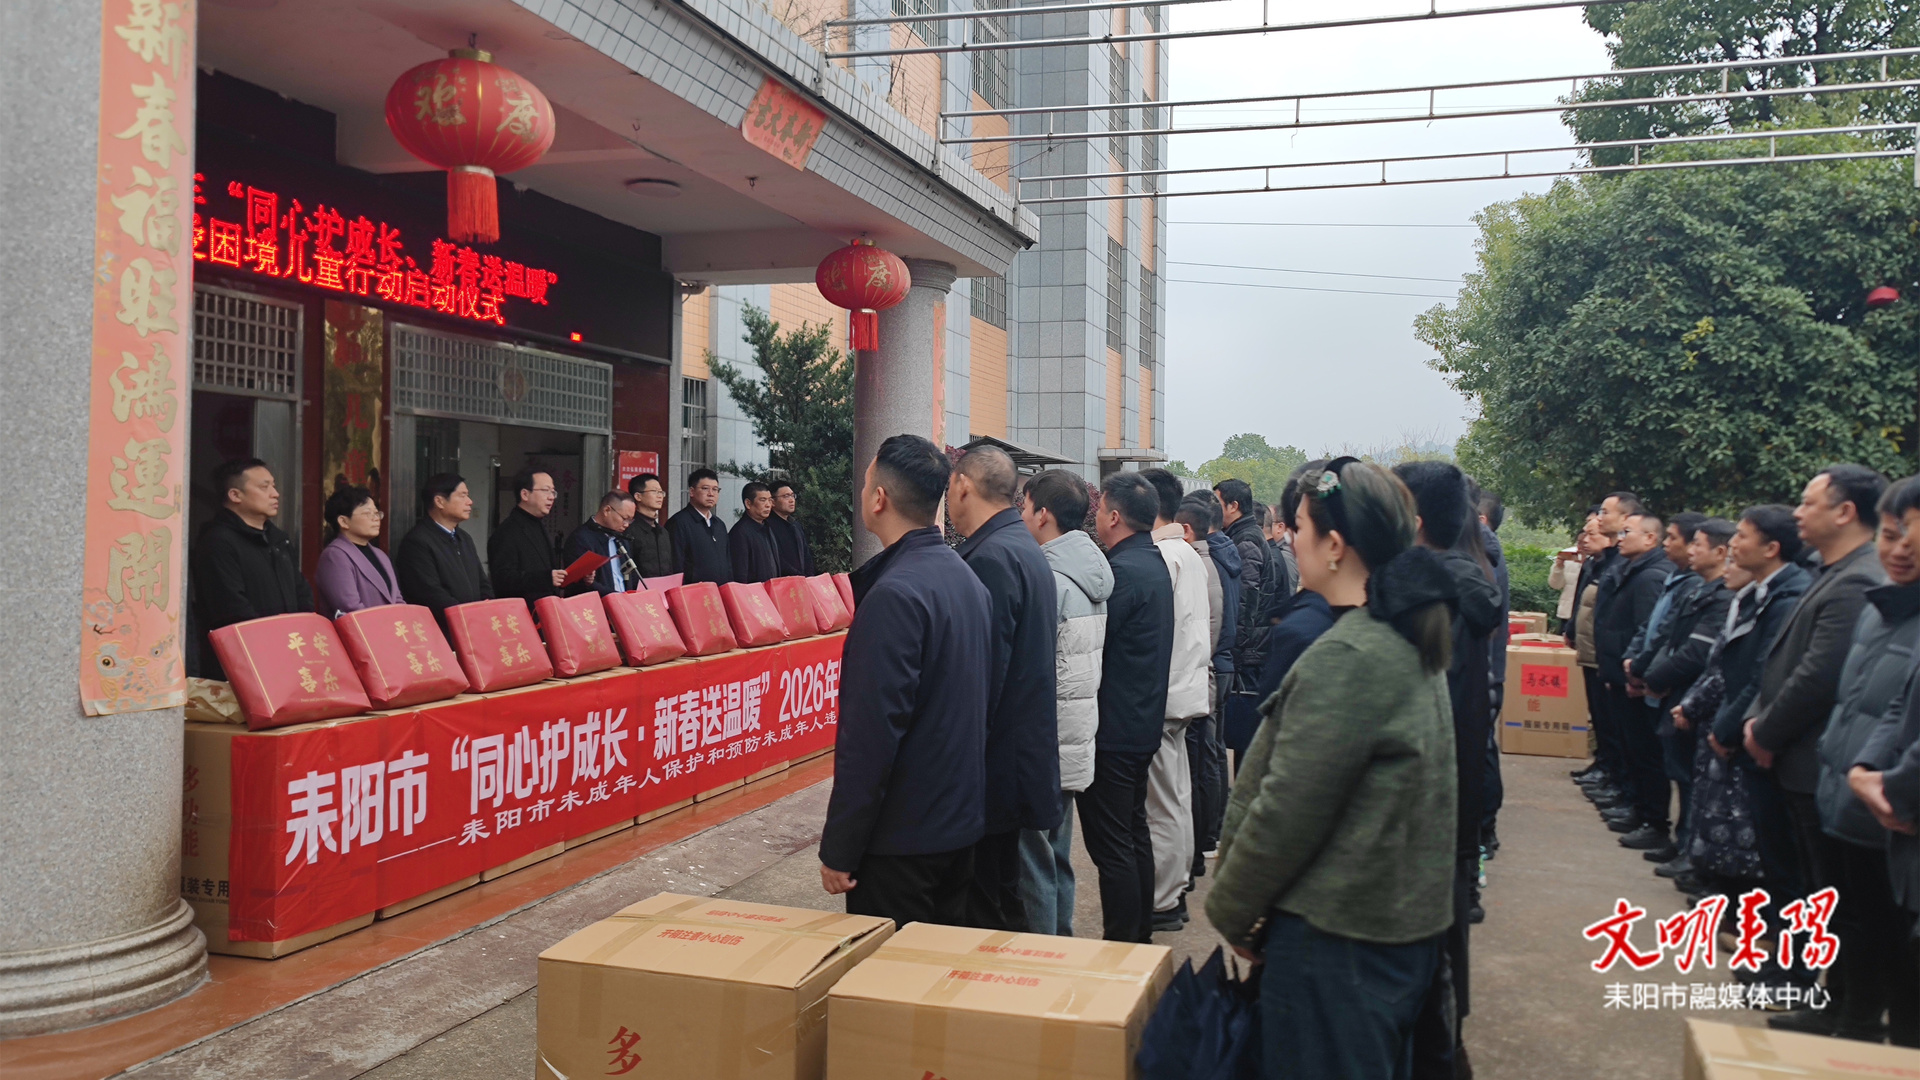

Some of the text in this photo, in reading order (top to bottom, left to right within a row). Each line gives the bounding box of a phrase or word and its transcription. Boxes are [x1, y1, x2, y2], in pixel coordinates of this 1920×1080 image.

[490, 614, 520, 636] 平安
[570, 608, 597, 629] 平安
[394, 620, 428, 643] 平安
[288, 632, 330, 656] 平安
[499, 643, 531, 667] 喜乐
[406, 650, 442, 675] 喜乐
[298, 667, 339, 693] 喜乐
[285, 749, 429, 866] 耒阳市
[779, 658, 841, 722] 2026年
[657, 929, 744, 946] 开箱注意小心划伤
[947, 969, 1042, 987] 开箱注意小心划伤
[604, 1025, 642, 1076] 多
